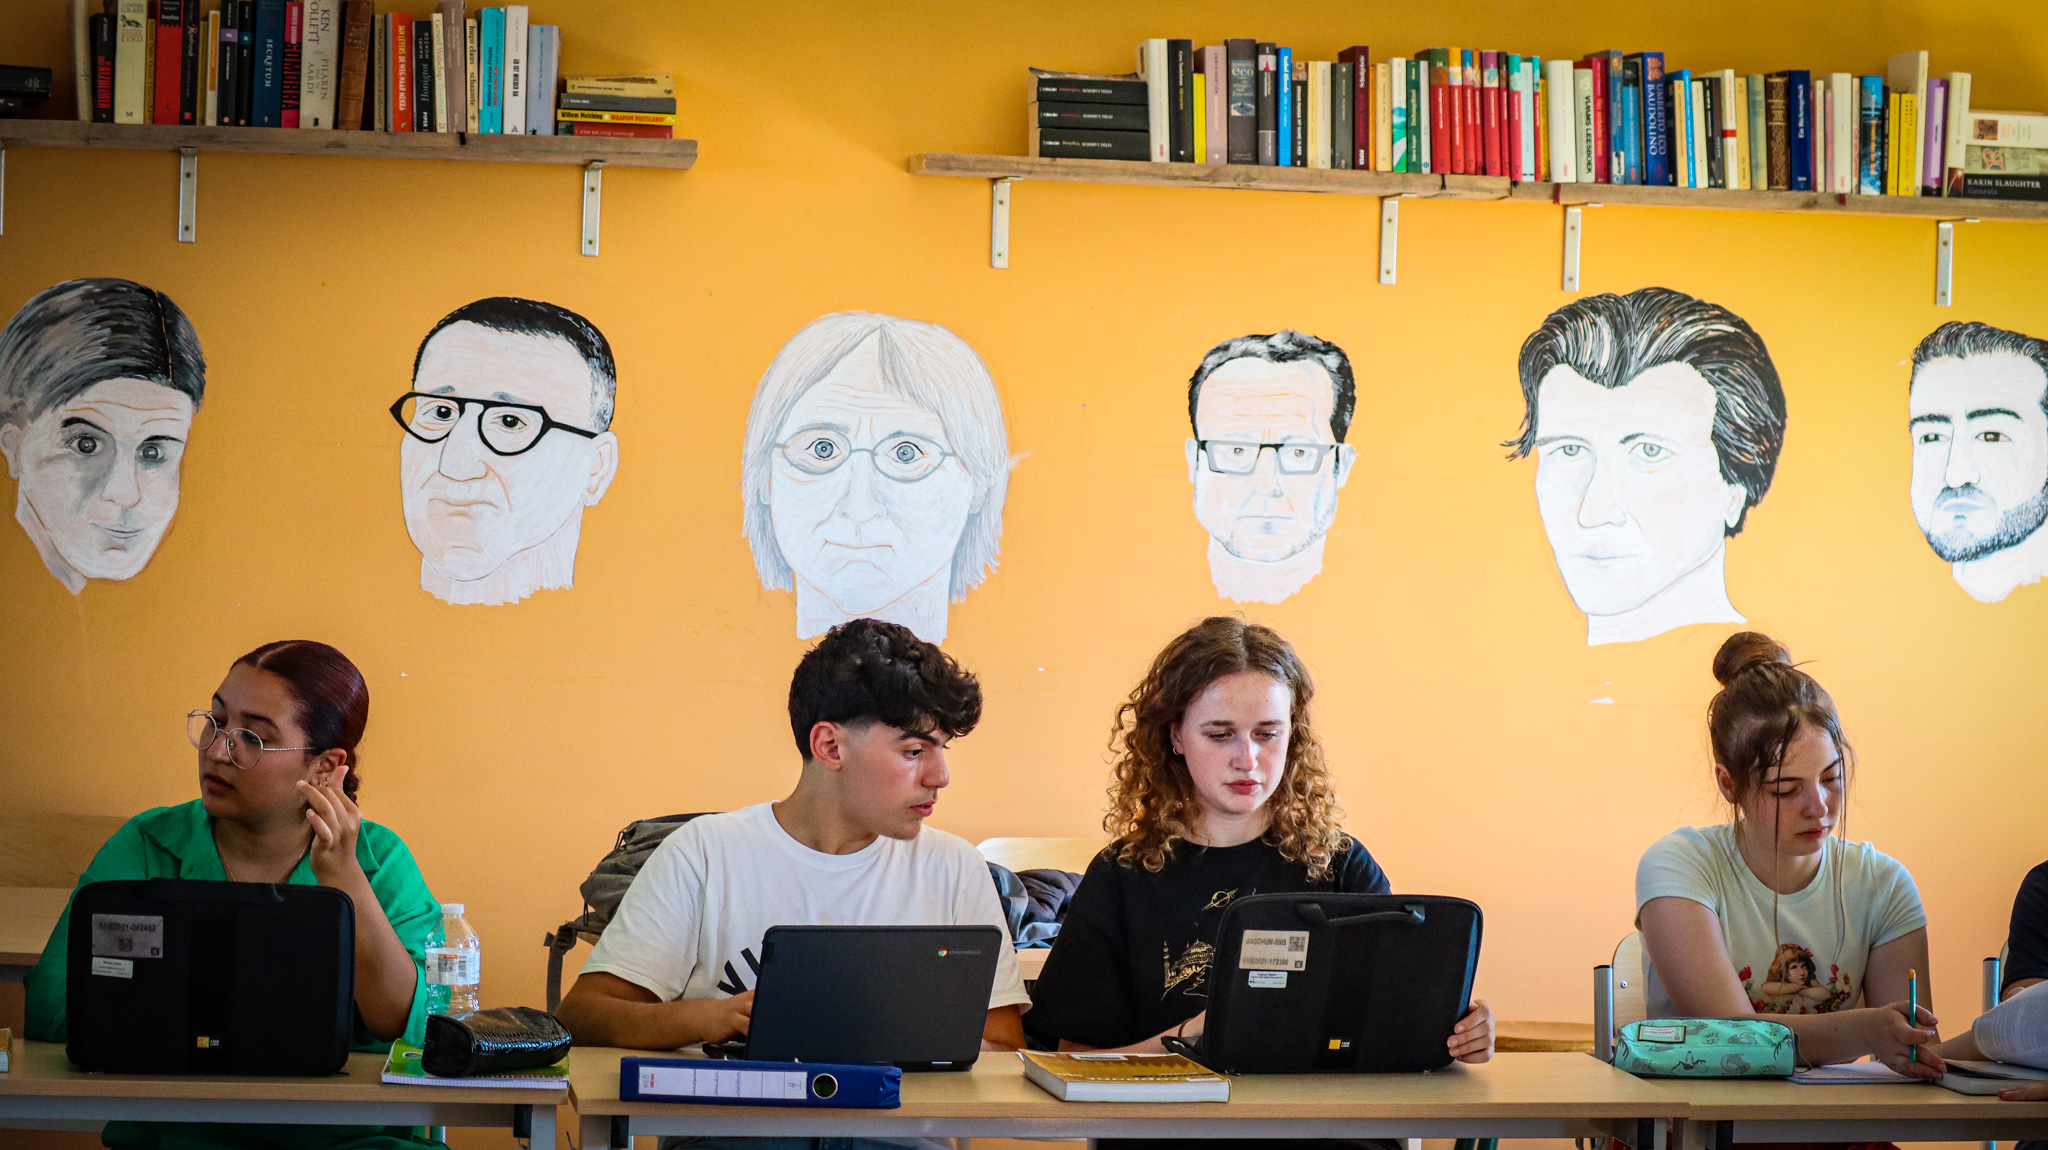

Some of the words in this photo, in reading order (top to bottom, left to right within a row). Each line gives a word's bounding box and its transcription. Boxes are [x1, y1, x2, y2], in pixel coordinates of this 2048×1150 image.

[320, 9, 330, 32] KEN
[398, 25, 406, 35] JAN
[469, 25, 477, 44] hugo
[398, 35, 406, 55] LEYERS
[469, 45, 477, 65] claus
[264, 38, 273, 88] SECRETUM
[398, 56, 406, 64] DE
[398, 64, 406, 76] WEG
[435, 47, 445, 80] Walschap
[281, 43, 302, 110] GOMORRA
[306, 62, 316, 96] AARDE
[320, 58, 330, 100] PILAREN
[1232, 67, 1254, 77] eco
[98, 66, 112, 109] ALZHEIMER
[398, 77, 406, 92] NAAR
[421, 63, 432, 102] Honigtot
[398, 92, 407, 111] MEKKA
[1656, 84, 1665, 131] UMBERTO
[561, 111, 580, 119] Willem
[580, 112, 603, 120] Melching
[1648, 84, 1658, 155] BAUDOLINO
[1658, 134, 1666, 155] ECO
[1967, 178, 1993, 186] KARIN
[1995, 179, 2041, 189] SLAUGHTER
[1967, 187, 1998, 195] Genesis
